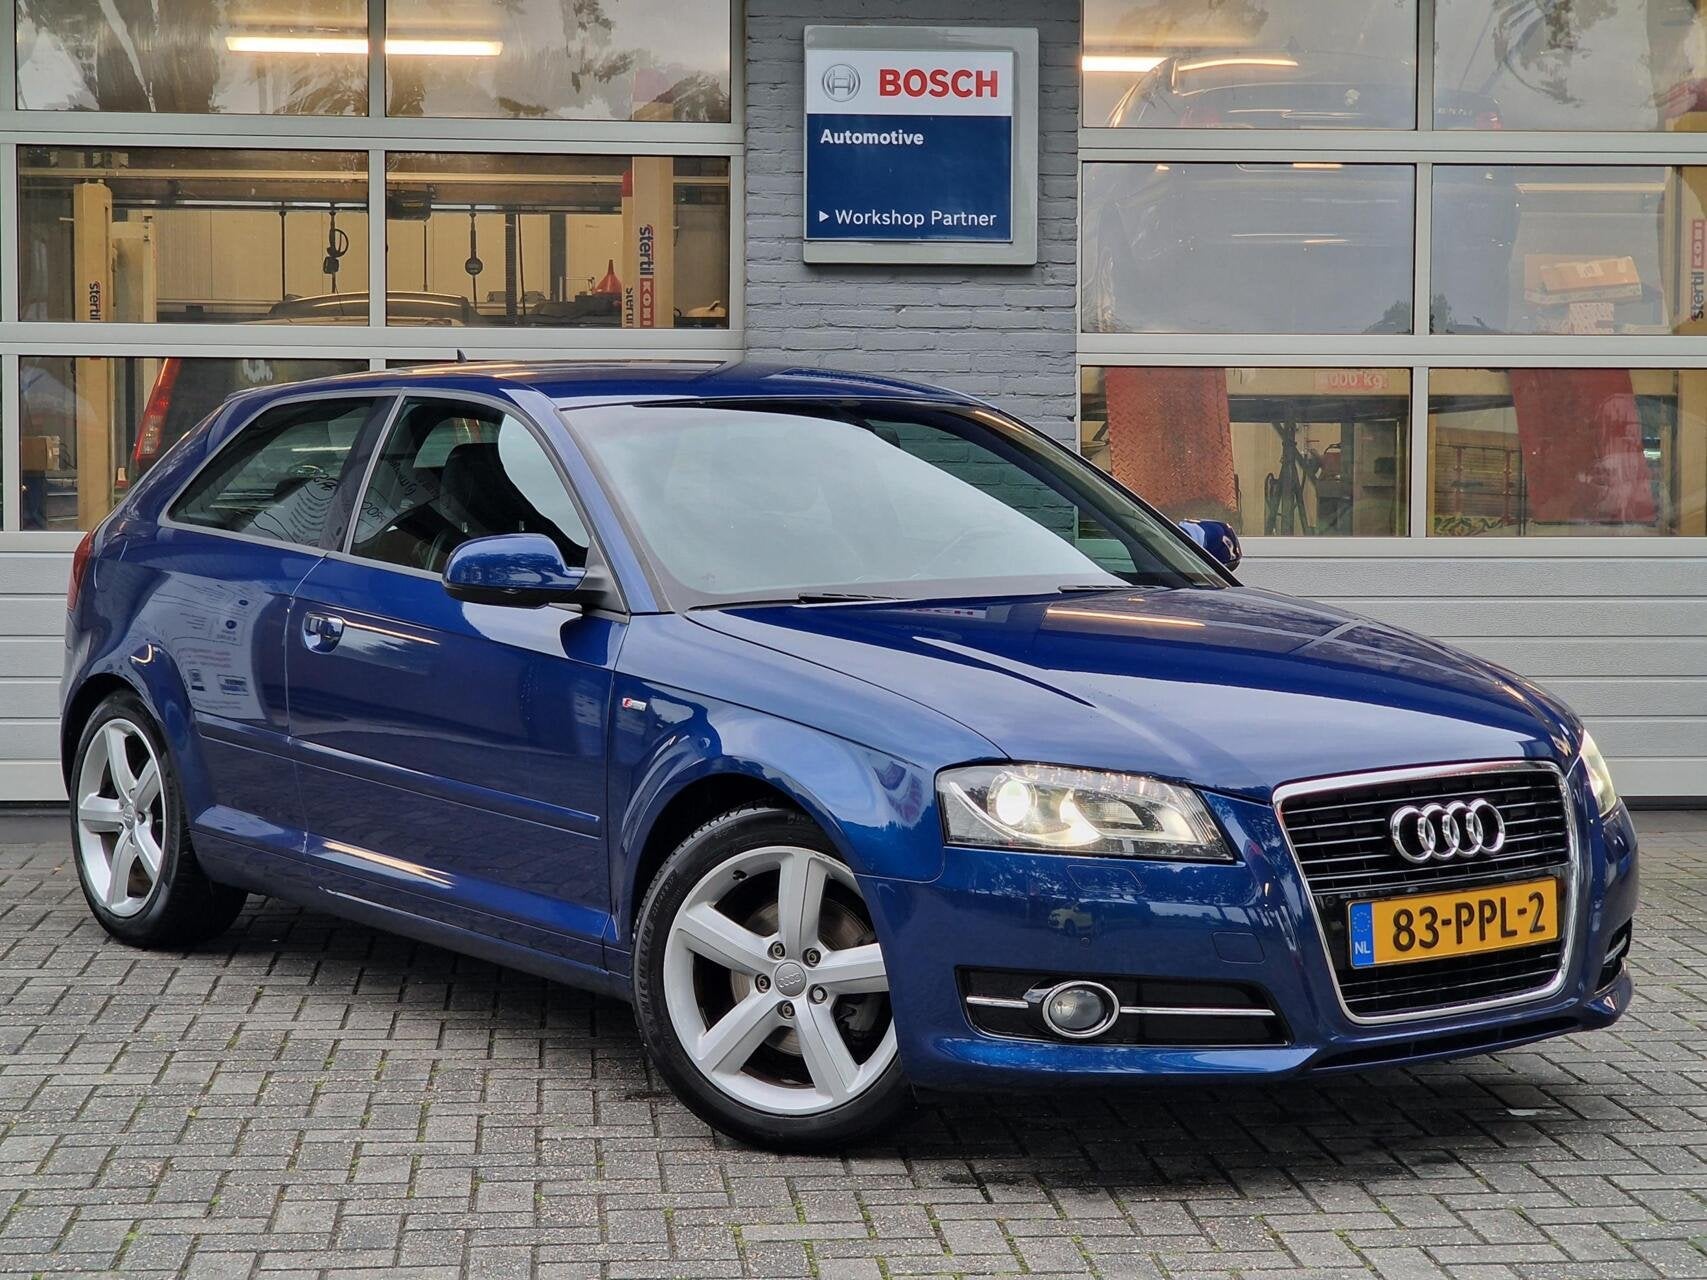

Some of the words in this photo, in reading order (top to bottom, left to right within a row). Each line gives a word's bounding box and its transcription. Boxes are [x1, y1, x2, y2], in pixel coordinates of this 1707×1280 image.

[879, 69, 998, 97] BOSCH
[820, 128, 924, 145] Automotive
[835, 209, 925, 228] Workshop
[931, 210, 997, 226] Partner
[639, 225, 654, 276] stertil
[89, 281, 101, 320] stertil
[1691, 271, 1704, 320] stertil
[1392, 891, 1546, 952] 83-PPL-2
[1355, 941, 1371, 954] NL
